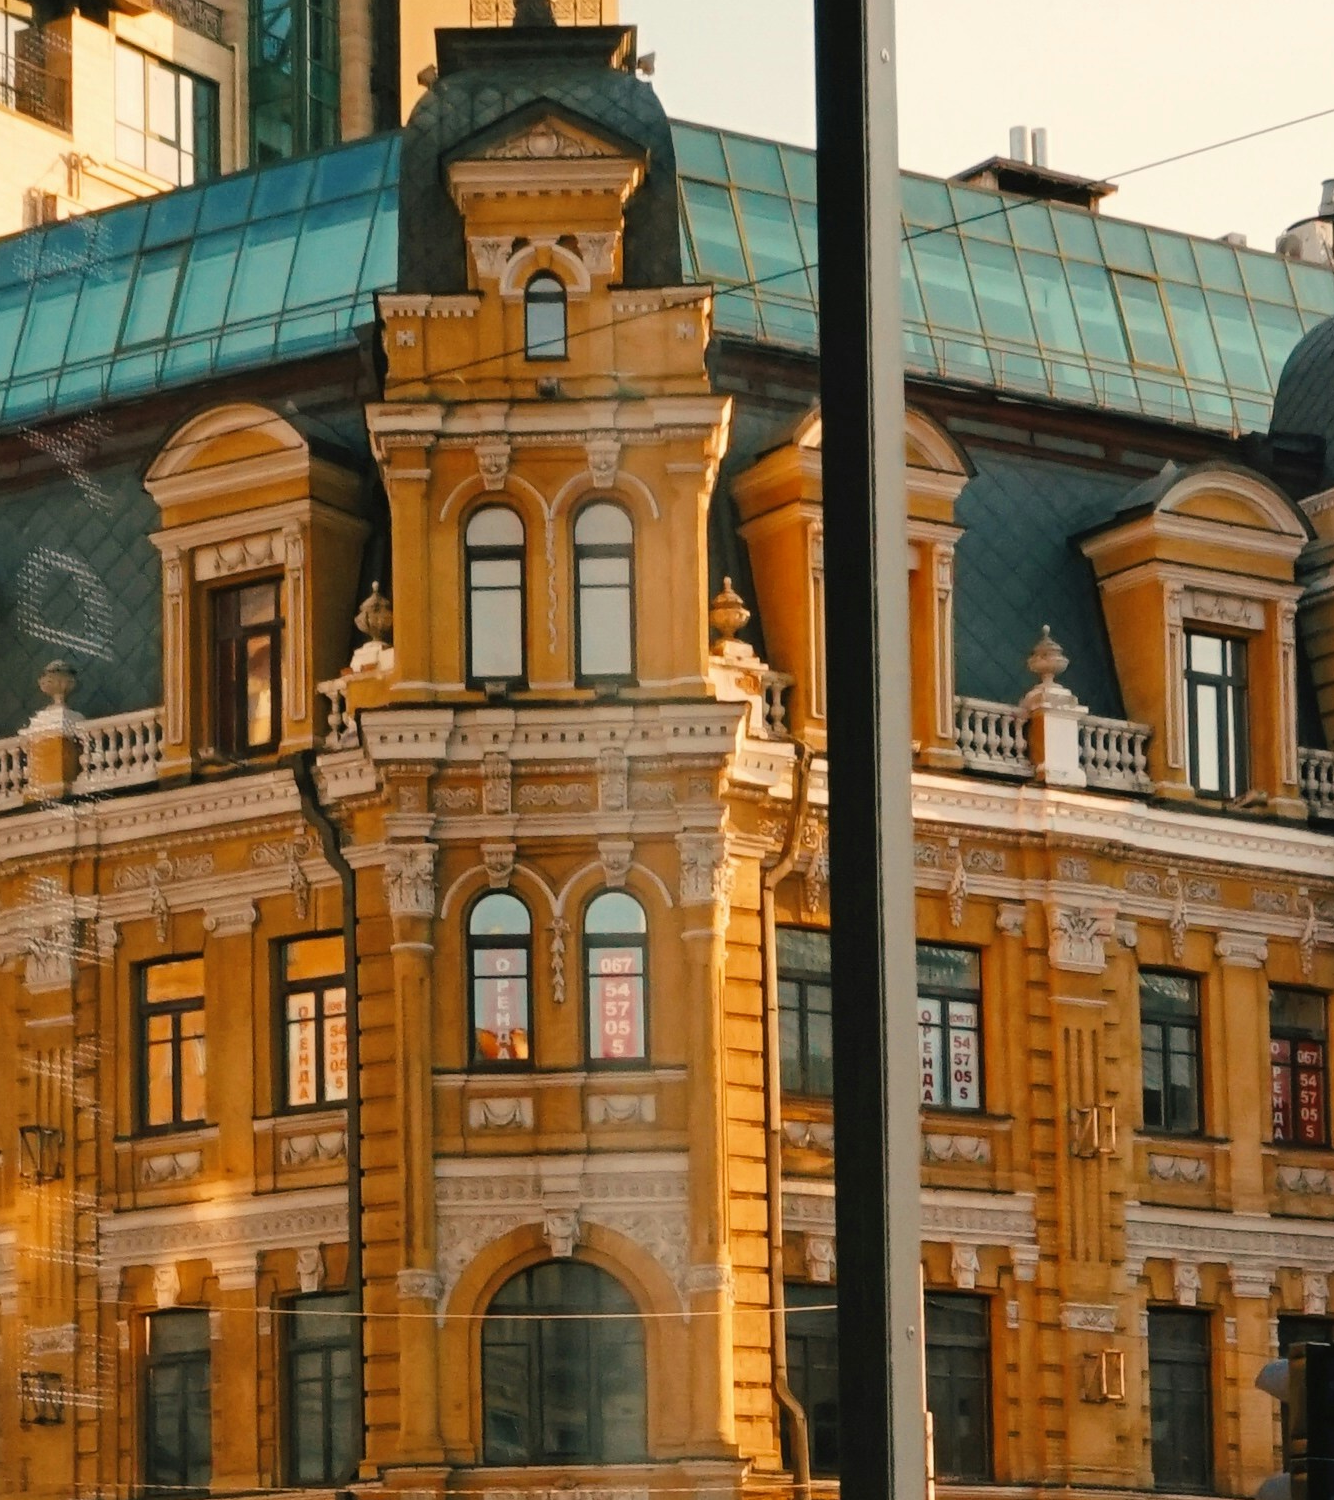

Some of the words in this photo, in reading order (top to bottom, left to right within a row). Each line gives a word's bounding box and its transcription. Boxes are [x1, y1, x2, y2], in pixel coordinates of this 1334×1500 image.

[600, 957, 633, 973] 067
[605, 982, 631, 998] 54
[605, 1001, 630, 1017] 57
[604, 1020, 631, 1035] 05
[611, 1039, 624, 1055] 5
[954, 1036, 971, 1049] 54
[954, 1053, 971, 1066] 57
[1297, 1050, 1318, 1064] 067
[335, 1076, 344, 1089] 5
[954, 1069, 972, 1083] 05
[1300, 1074, 1317, 1088] 54
[960, 1087, 969, 1099] 5
[1300, 1091, 1317, 1105] 57
[1300, 1107, 1318, 1122] 05
[1306, 1125, 1315, 1138] 5
